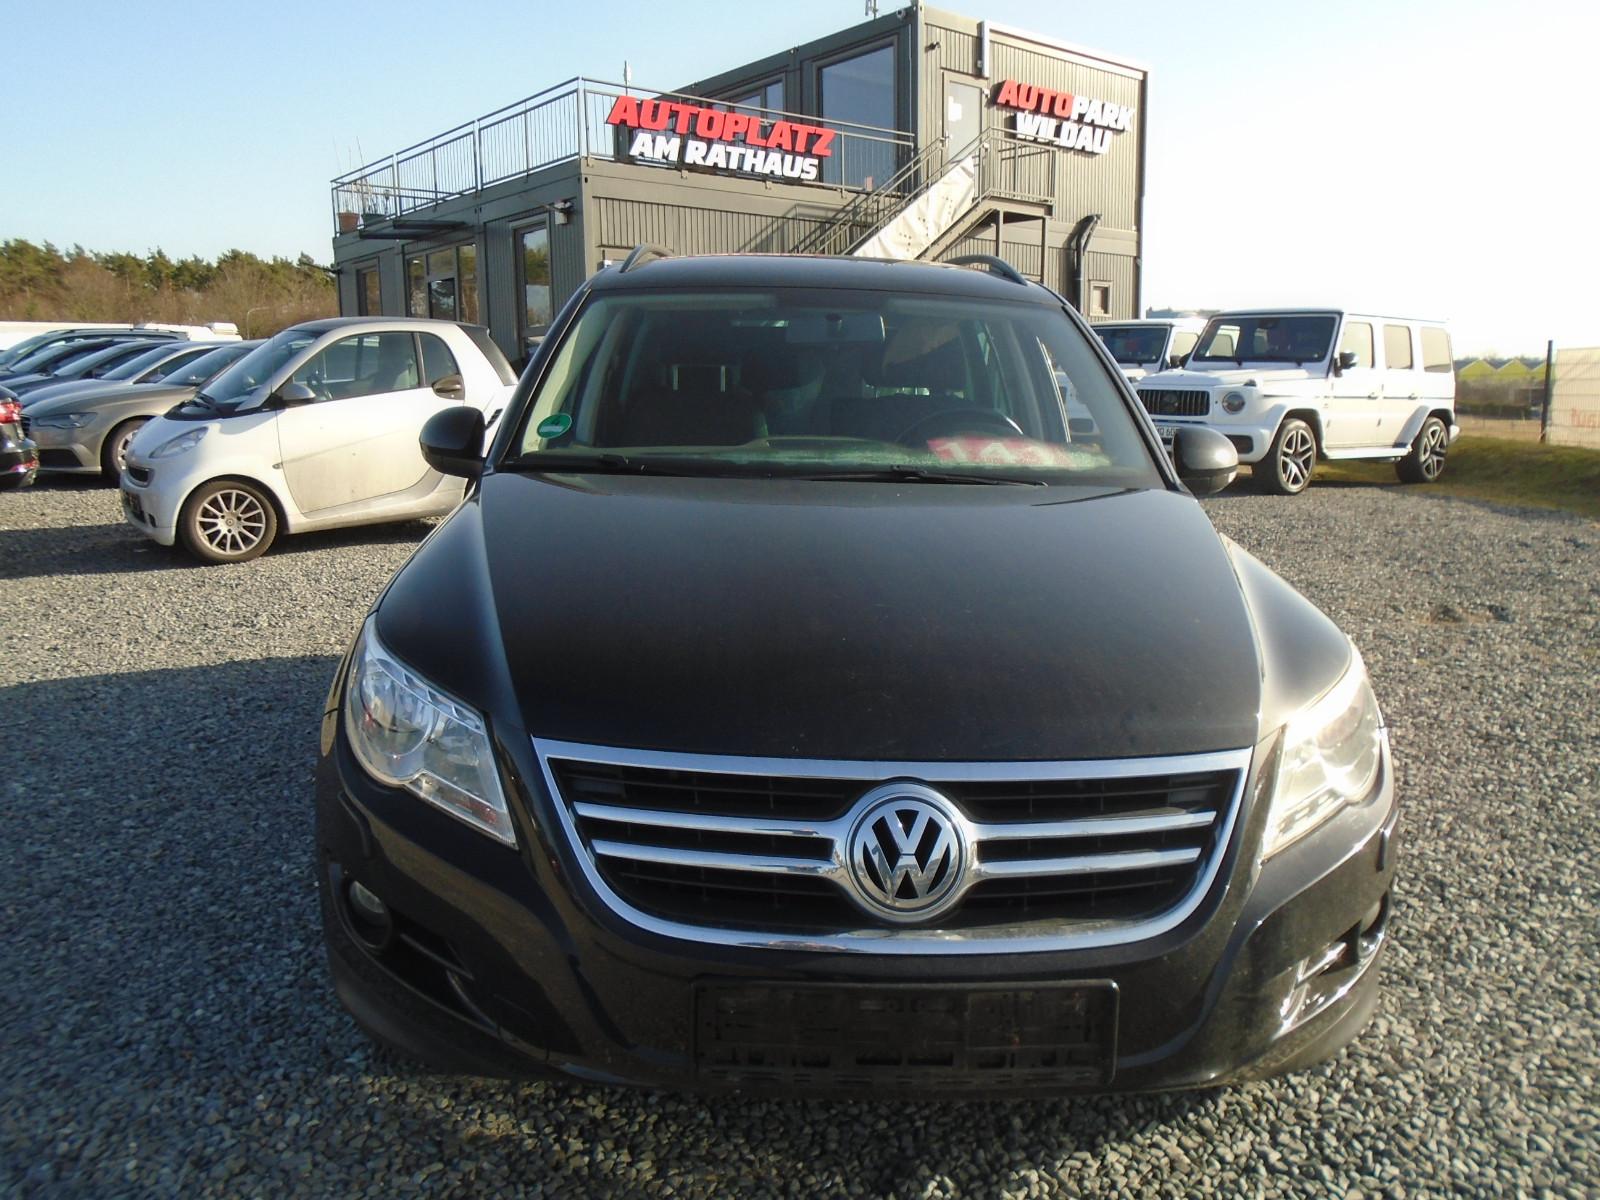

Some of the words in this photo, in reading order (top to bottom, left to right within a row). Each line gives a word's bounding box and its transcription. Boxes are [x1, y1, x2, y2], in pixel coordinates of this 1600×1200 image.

[606, 95, 836, 157] AUTOPLATZ
[997, 79, 1136, 131] AUTOPARK
[629, 133, 681, 162] AM
[684, 139, 819, 181] RATHAUS
[1016, 111, 1114, 154] WILDAU
